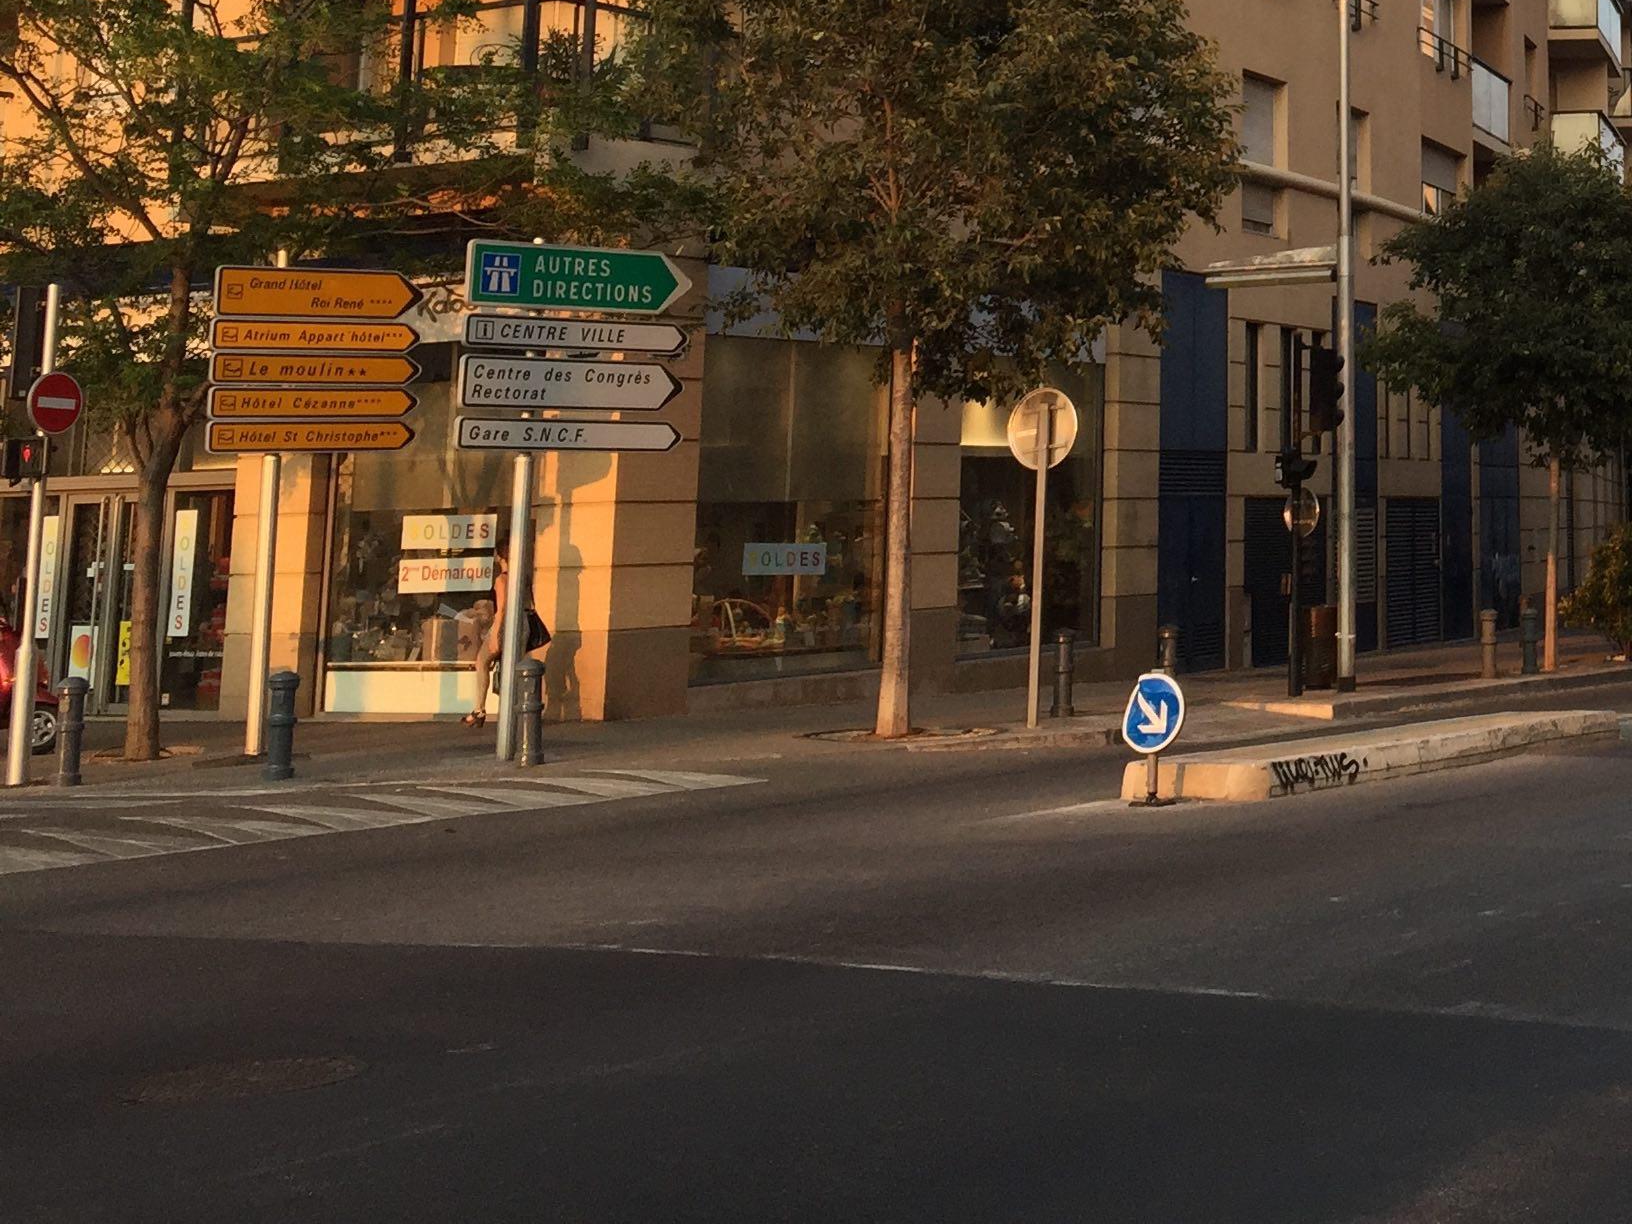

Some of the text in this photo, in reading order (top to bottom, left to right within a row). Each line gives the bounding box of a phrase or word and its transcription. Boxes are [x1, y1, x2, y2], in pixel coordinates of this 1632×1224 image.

[535, 255, 611, 277] AUTRES
[250, 278, 322, 291] Grand Hôtel
[532, 280, 652, 303] DIRECTIONS
[311, 297, 364, 309] Roi René
[244, 329, 290, 341] Atrium
[500, 324, 568, 341] CENTRE
[581, 327, 625, 344] VILLE
[249, 361, 344, 377] Le moulin
[473, 364, 651, 387] Centre des Congrès
[471, 384, 546, 401] Rectorat
[241, 397, 357, 409] Hôtel Cézanne
[239, 431, 378, 445] Hôtel St Christophe
[469, 426, 510, 441] Gare
[40, 521, 56, 632] OLDES
[175, 519, 190, 629] OLDES
